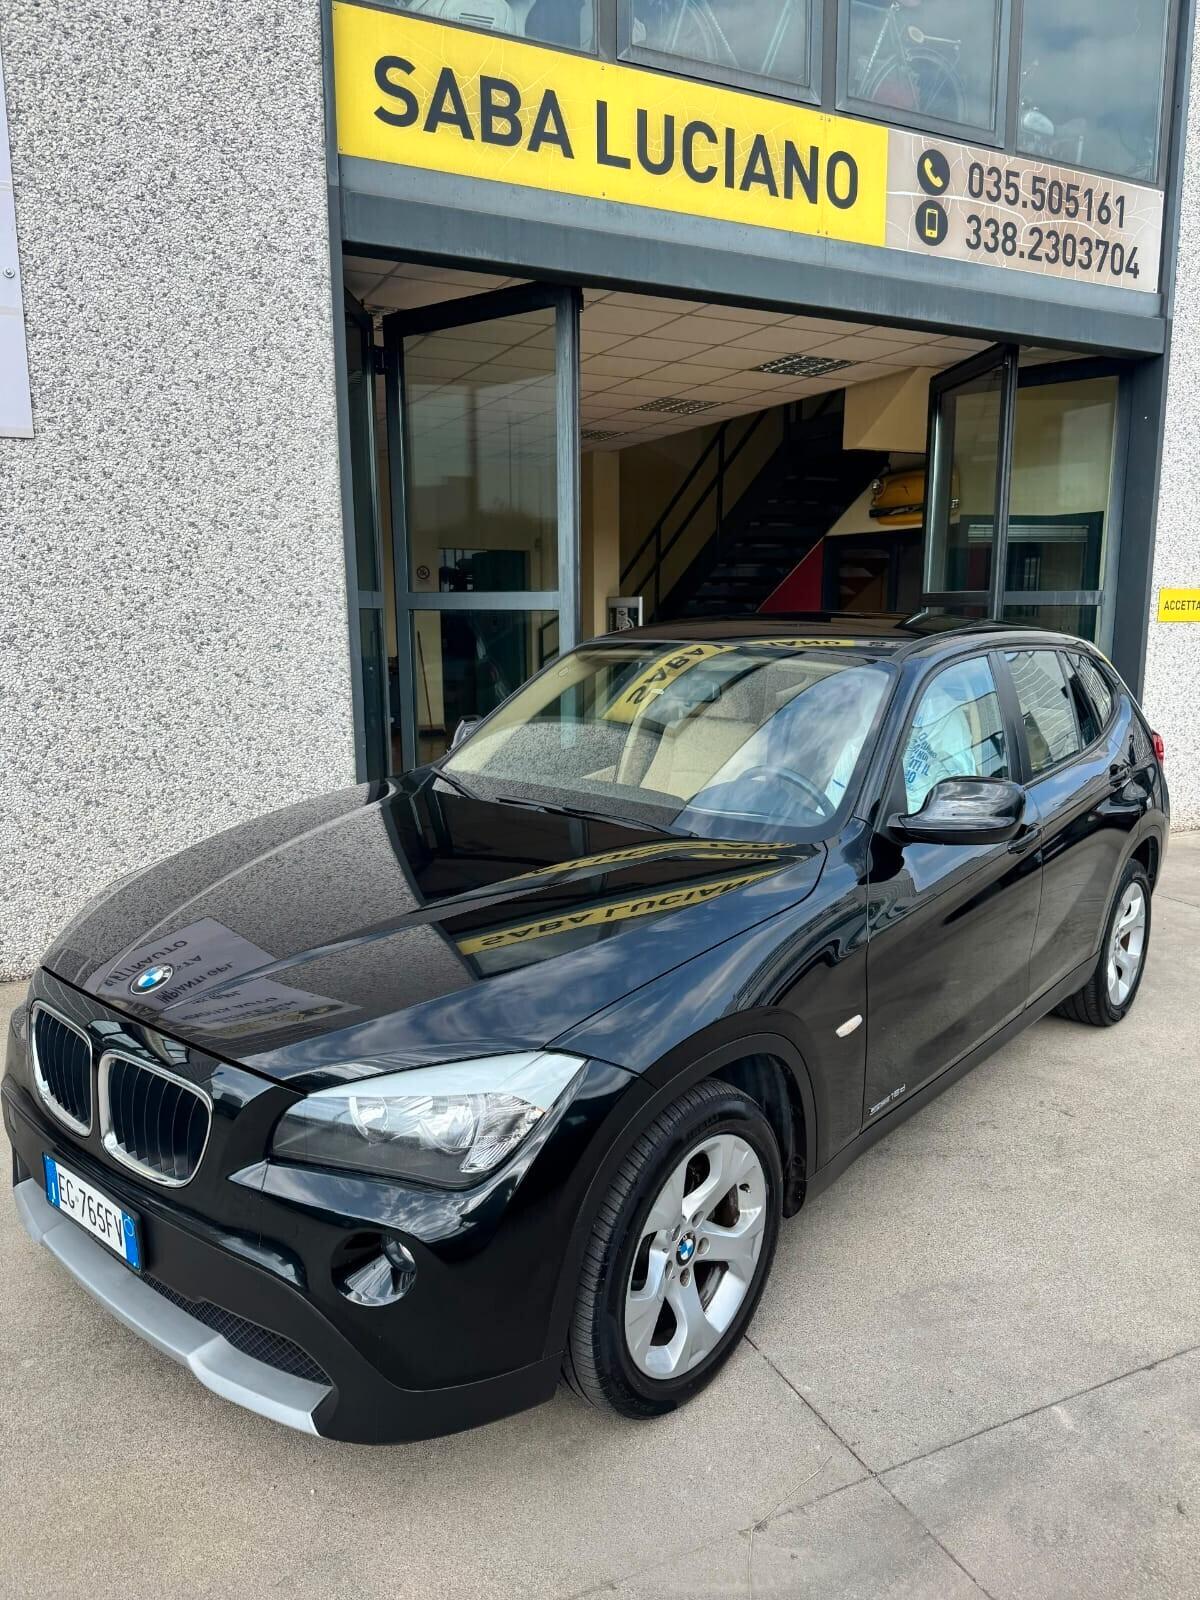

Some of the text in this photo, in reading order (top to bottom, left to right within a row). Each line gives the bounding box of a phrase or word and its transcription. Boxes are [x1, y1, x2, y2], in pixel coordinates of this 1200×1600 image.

[374, 55, 859, 210] SABA LUCIANO
[968, 162, 1125, 229] 035.505161
[965, 214, 1140, 279] 338.2303704
